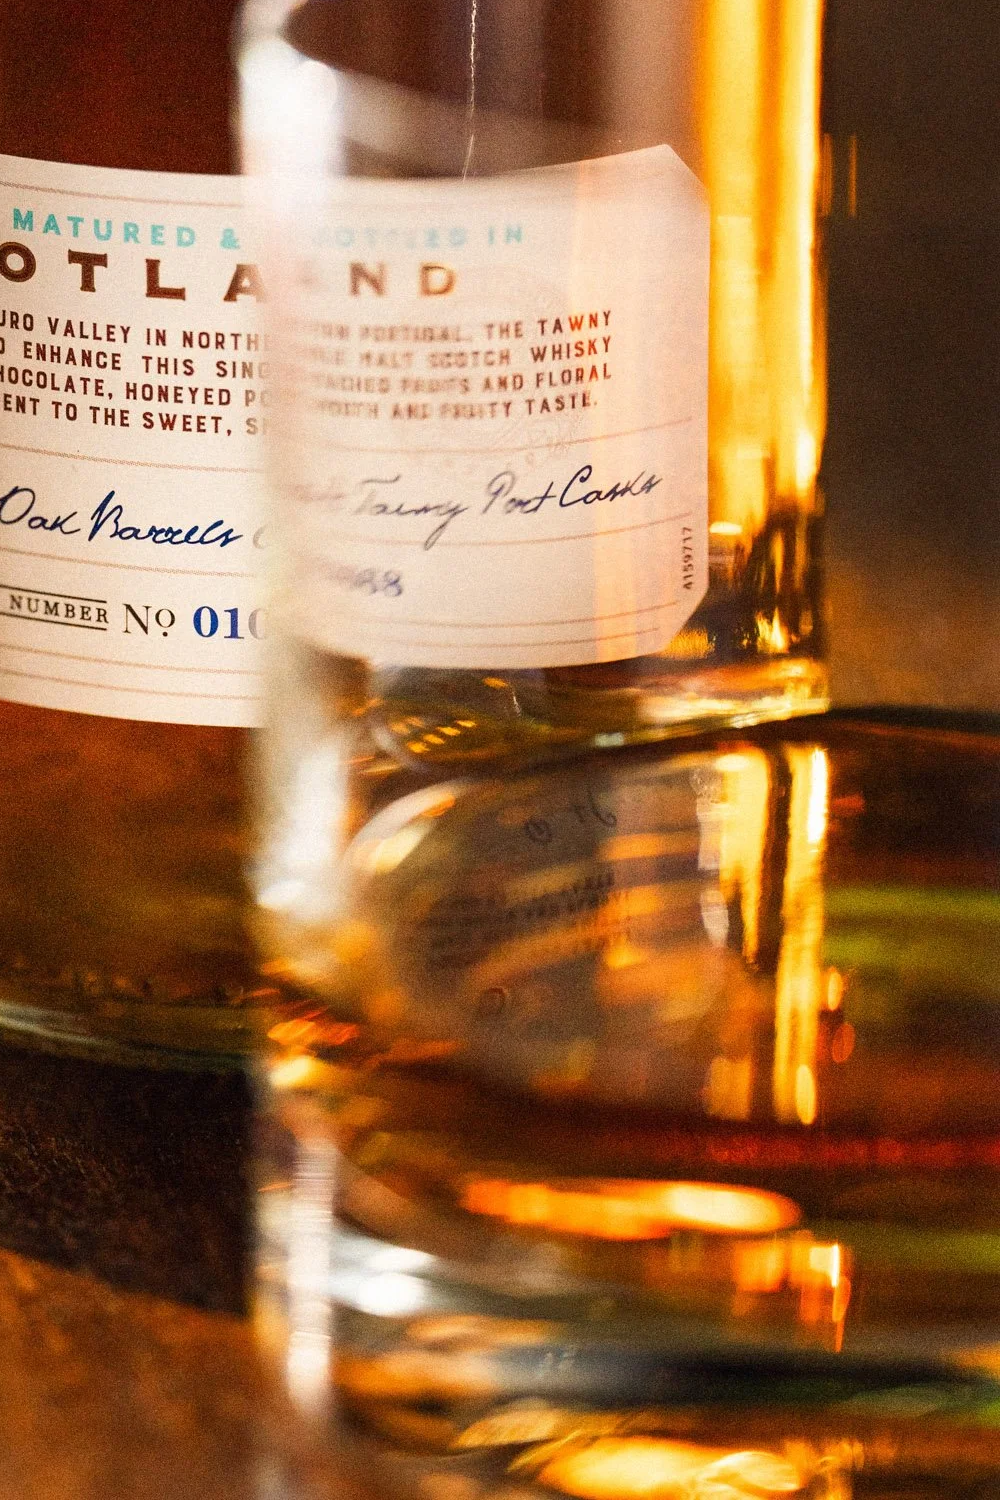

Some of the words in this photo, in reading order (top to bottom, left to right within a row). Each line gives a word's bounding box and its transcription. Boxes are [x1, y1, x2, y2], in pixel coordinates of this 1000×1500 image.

[13, 207, 196, 248] MATURED
[219, 227, 241, 250] &
[47, 316, 131, 344] VALLEY
[146, 327, 167, 347] IN
[484, 320, 524, 340] THE
[537, 309, 612, 336] TAWNY
[23, 341, 122, 371] ENHANCE
[142, 355, 195, 377] THIS
[530, 335, 612, 364] WHISKY
[125, 381, 231, 407] HONEYED
[535, 362, 612, 390] FLORAL
[52, 400, 77, 421] TO
[89, 406, 130, 428] THE
[142, 411, 232, 437] SWEET,
[525, 393, 598, 416] TASTE.
[90, 489, 244, 548] Barrels
[558, 464, 662, 508] Casks
[9, 595, 108, 624] NUMBER
